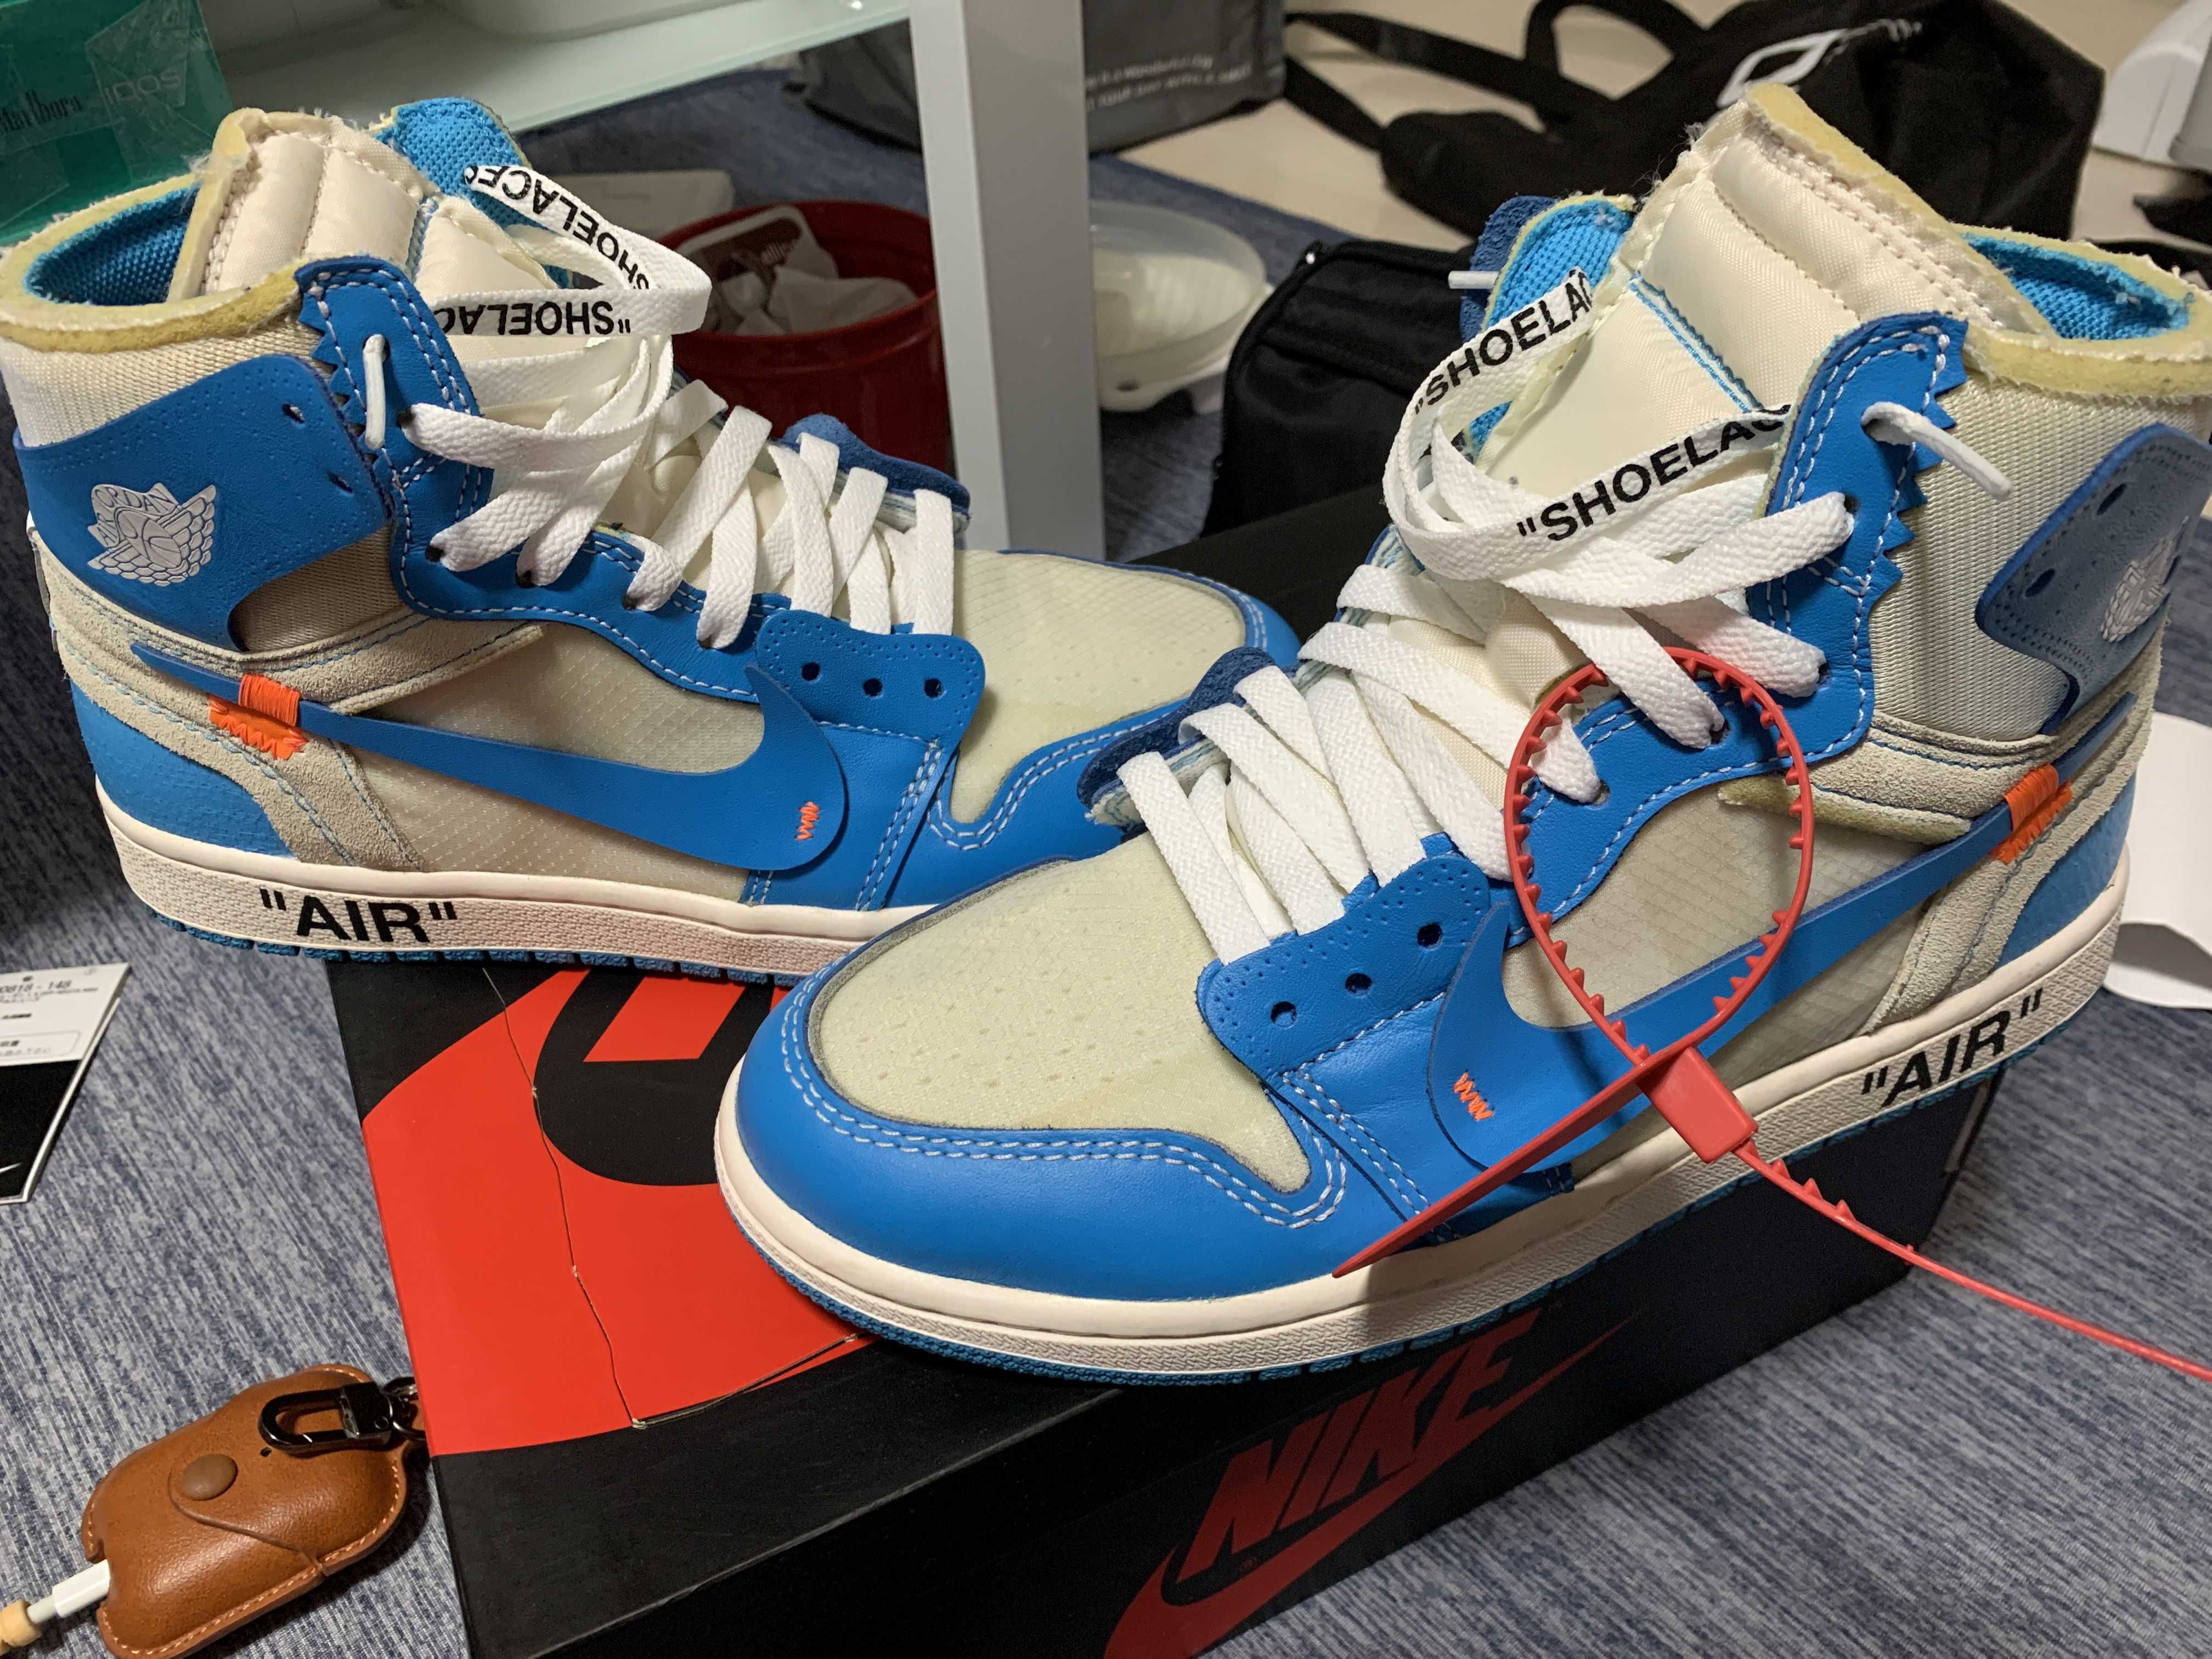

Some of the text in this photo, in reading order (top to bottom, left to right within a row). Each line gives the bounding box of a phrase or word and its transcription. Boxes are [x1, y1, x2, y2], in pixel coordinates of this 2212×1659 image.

[104, 68, 183, 105] IQOS
[259, 888, 458, 943] "AIR"
[1861, 988, 2042, 1108] "AIR"
[1175, 1307, 1543, 1584] NIKE
